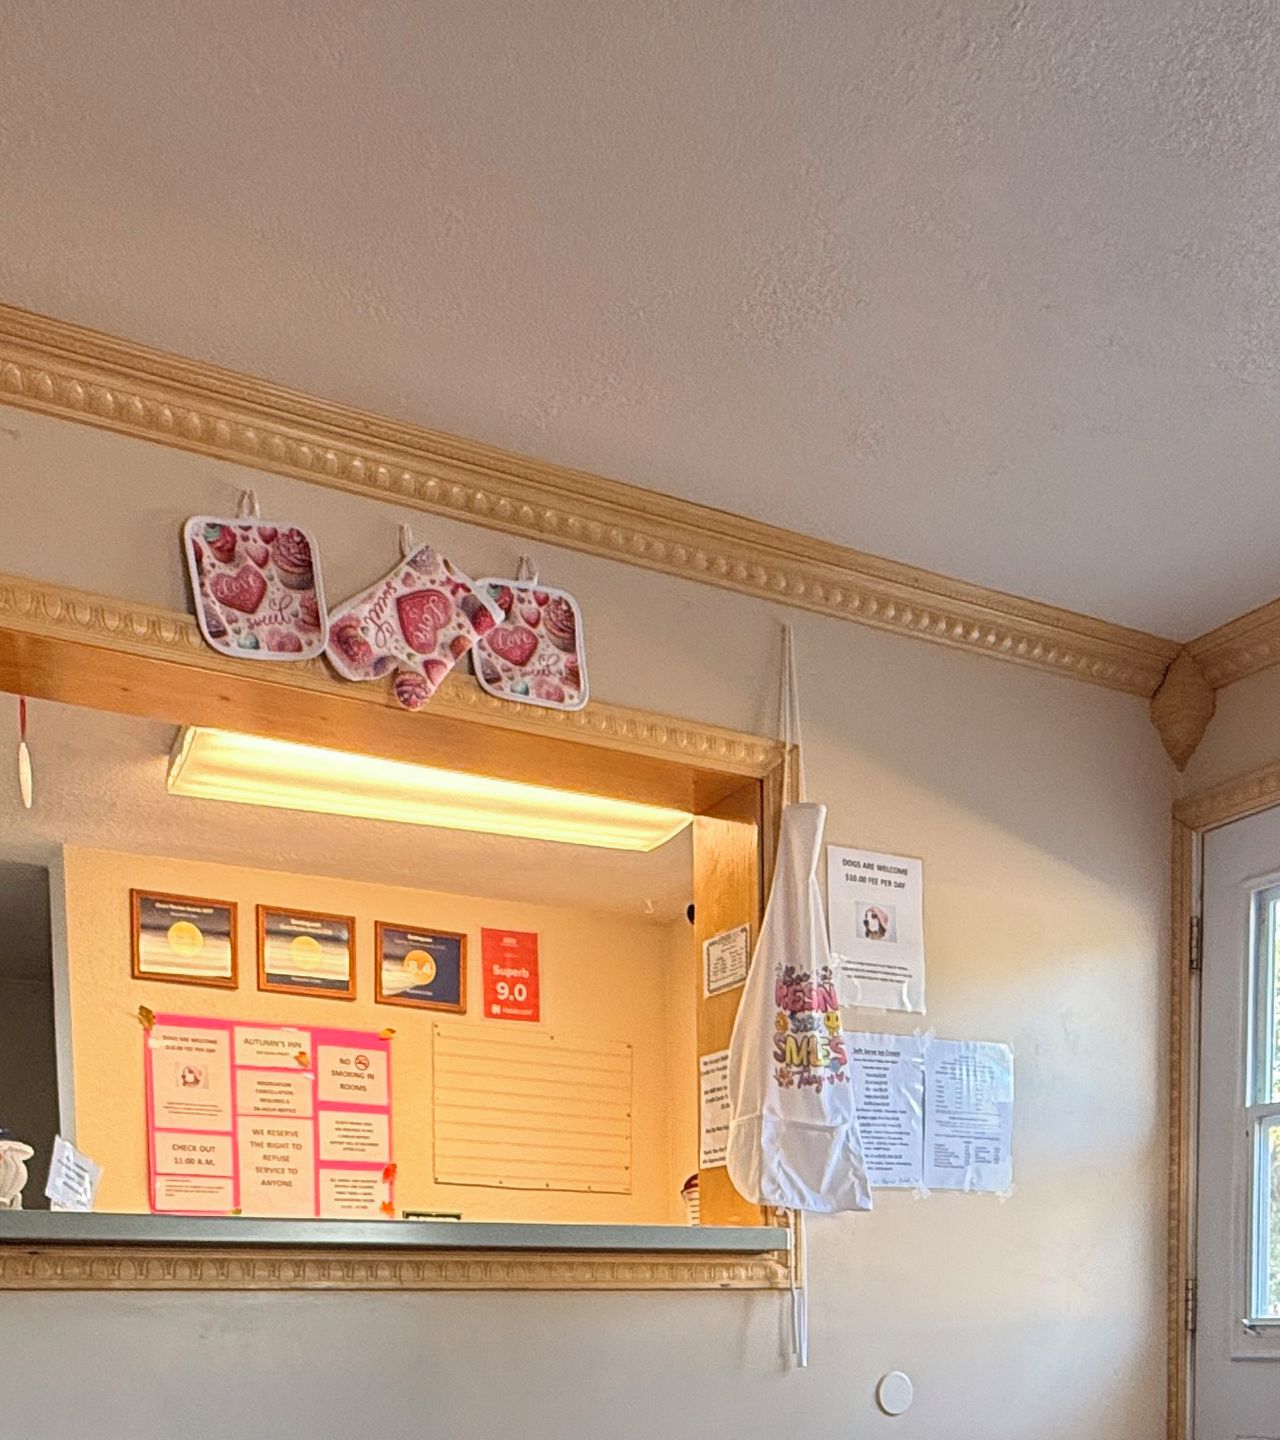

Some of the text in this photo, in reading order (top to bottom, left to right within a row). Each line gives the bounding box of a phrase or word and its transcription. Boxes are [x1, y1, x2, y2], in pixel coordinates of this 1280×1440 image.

[842, 858, 909, 876] DOGS ARE WELCOME
[493, 964, 530, 979] Superb
[496, 981, 528, 1002] 9.0
[287, 1041, 302, 1049] INN
[339, 1057, 351, 1067] NO
[331, 1069, 366, 1080] SMOKING
[339, 1083, 367, 1093] ROOMS
[251, 1128, 299, 1138] WE RESERVE
[172, 1144, 216, 1153] CHECK OUT
[250, 1141, 302, 1151] THE RIGHT TO
[286, 1168, 298, 1176] TO
